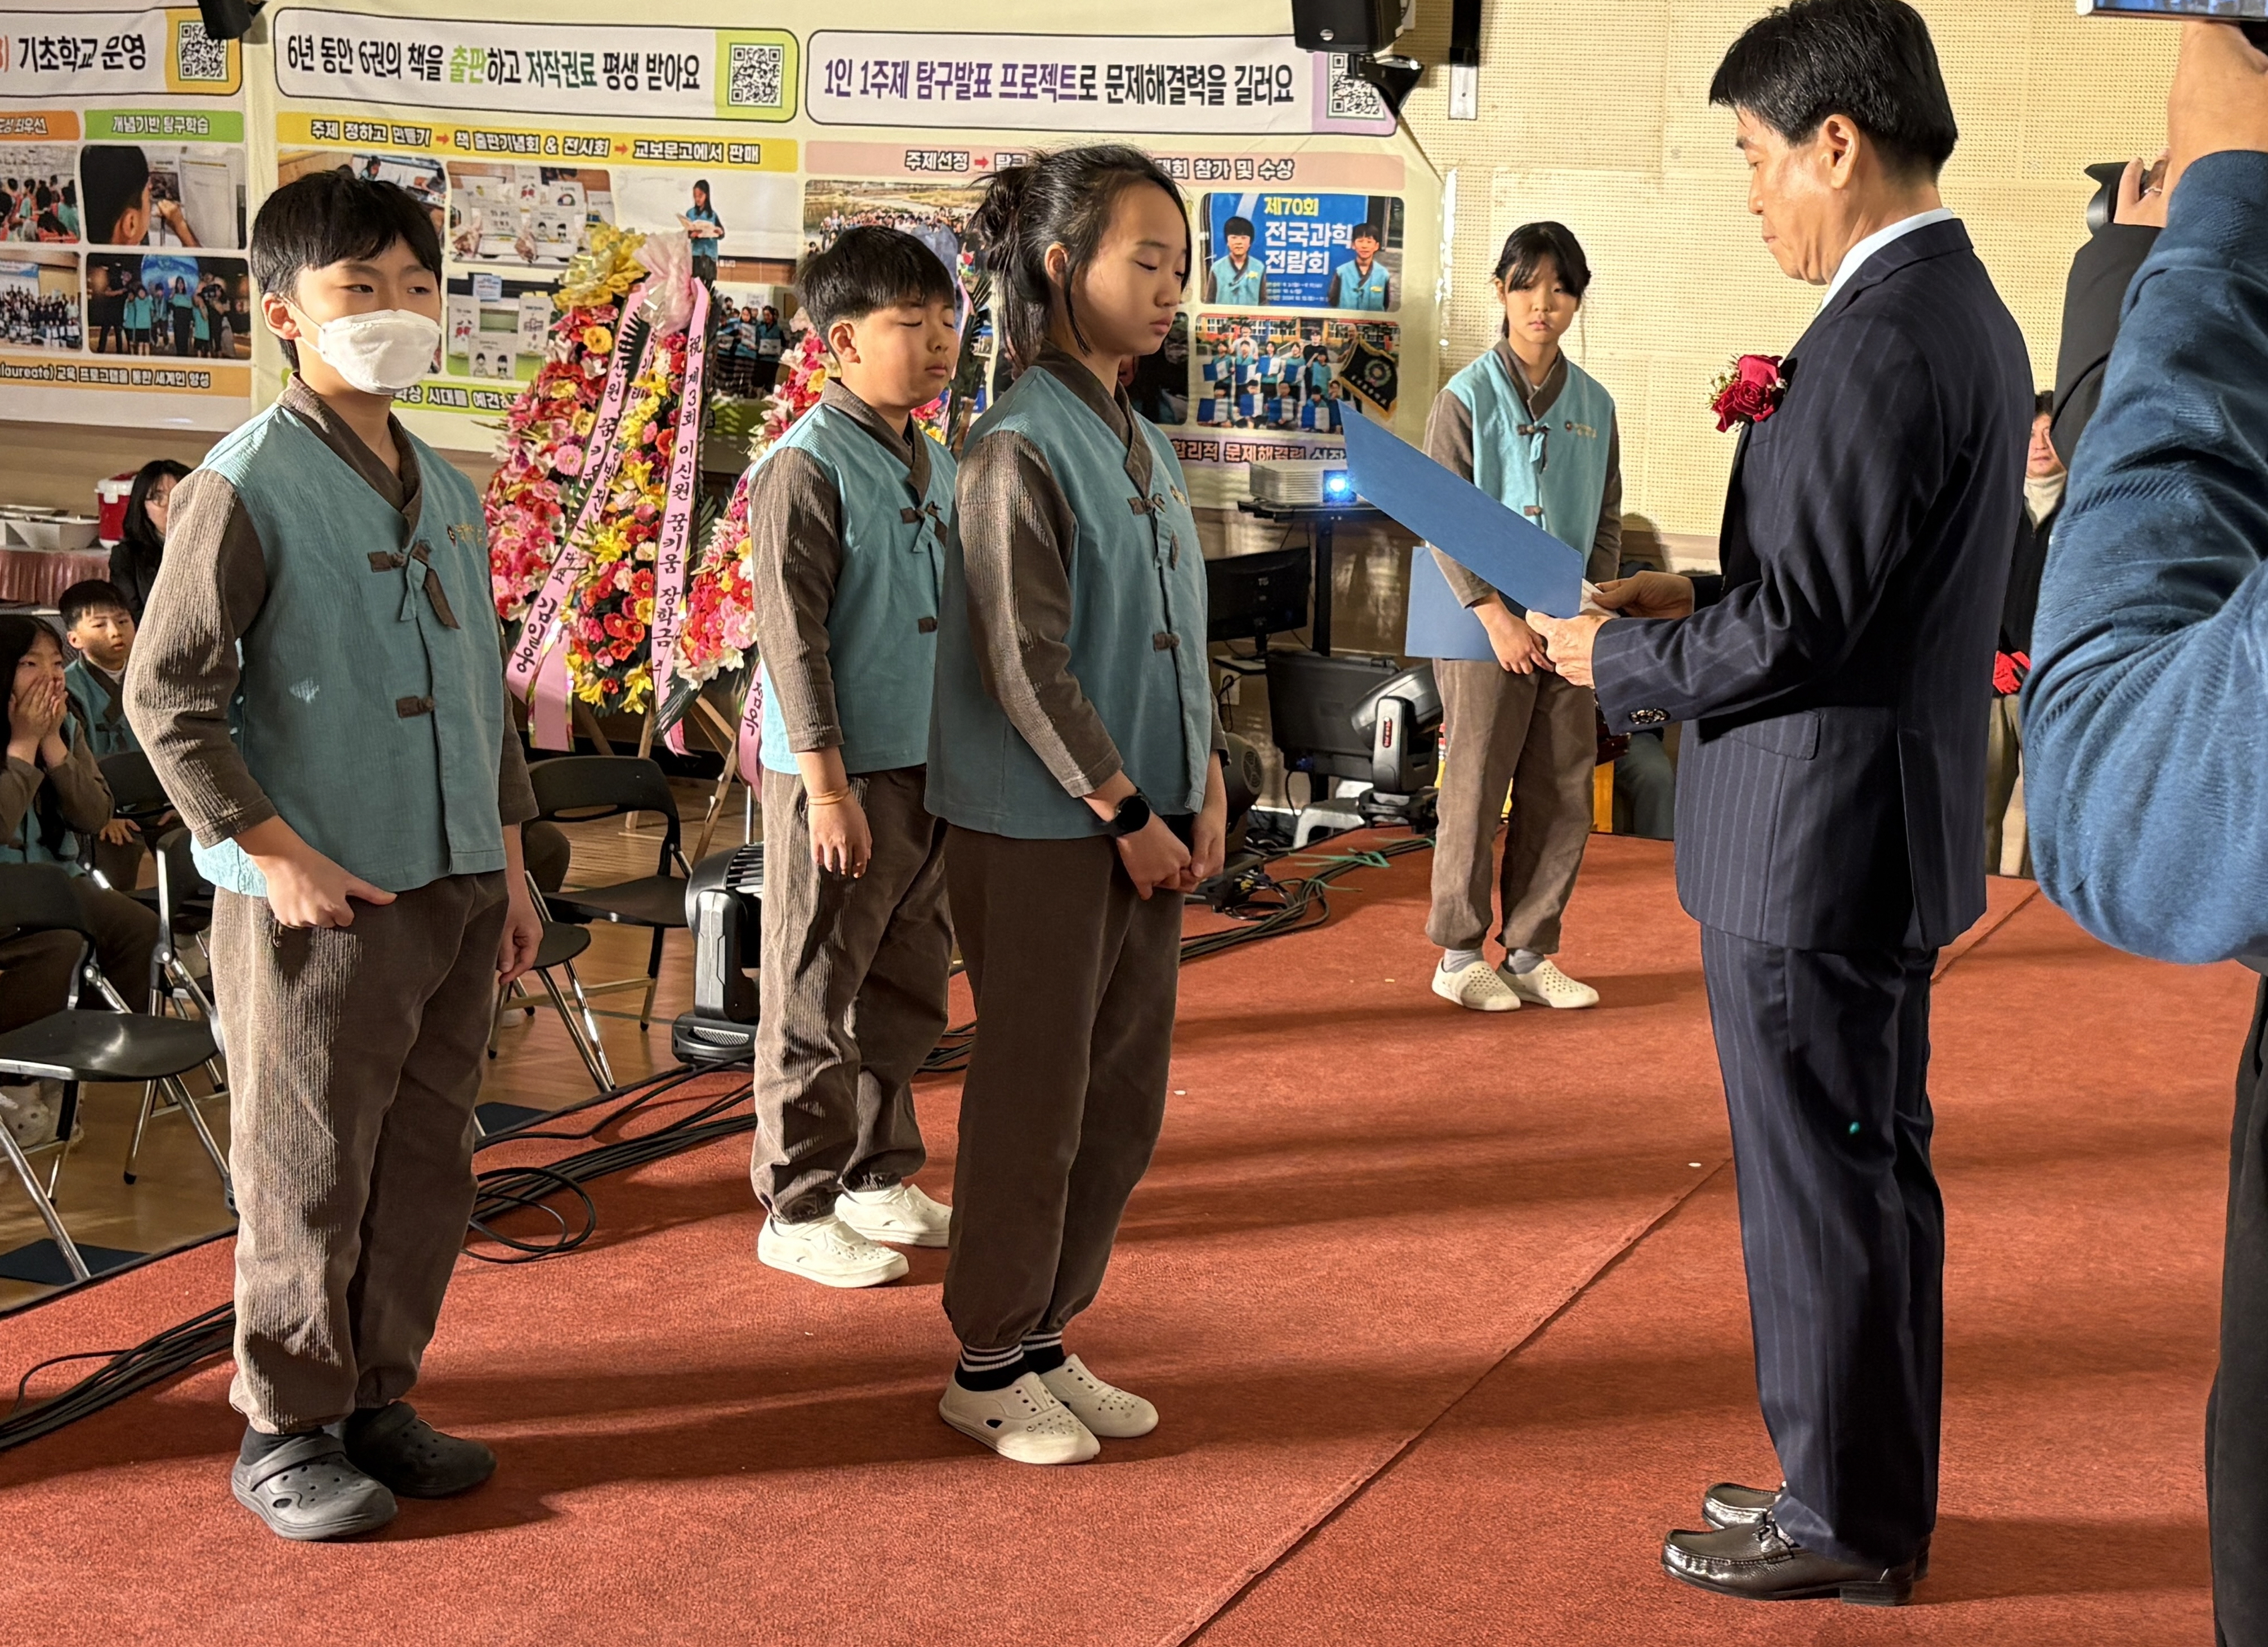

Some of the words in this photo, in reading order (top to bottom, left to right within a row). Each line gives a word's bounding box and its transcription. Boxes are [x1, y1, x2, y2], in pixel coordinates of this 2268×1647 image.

[19, 35, 97, 73] 기초학교
[101, 34, 146, 70] 운영
[287, 34, 314, 73] 6년
[321, 38, 353, 72] 동안
[358, 41, 402, 79] 6권의
[407, 43, 444, 82] 책을
[450, 45, 521, 84] 출판하고
[526, 50, 598, 88] 저작권료
[602, 52, 639, 91] 평생
[646, 53, 700, 92] 받아요
[824, 59, 852, 97] 1인
[860, 60, 909, 100] 1주제
[917, 61, 993, 100] 탐구발표
[999, 63, 1098, 102] 프로젝트로
[1105, 64, 1226, 106] 문제해결력을
[1235, 65, 1294, 105] 길러요
[113, 115, 160, 133] 개념기반
[163, 115, 209, 135] 탐구학습
[311, 119, 338, 139] 주제
[343, 122, 387, 142] 정하고
[391, 126, 431, 146] 만들기
[454, 131, 470, 150] 책
[474, 131, 540, 153] 출판기념회
[544, 136, 558, 154] &
[563, 136, 610, 157] 전시회
[633, 140, 724, 162] 교보문고에서
[728, 143, 761, 164] 판매
[905, 150, 970, 172] 주제선정
[1194, 158, 1231, 179] 참가
[1235, 159, 1254, 179] 및
[1258, 159, 1294, 180] 수상
[1264, 197, 1319, 217] 제70회
[1265, 251, 1329, 275] 전람회
[688, 334, 703, 357] 祝
[0, 361, 54, 380] laureate)
[56, 365, 77, 382] 교육
[79, 366, 129, 385] 프로그램을
[154, 370, 186, 387] 세계인
[427, 386, 469, 408] 시대를
[659, 512, 688, 574] 꿈키움
[651, 586, 681, 648] 장학금
